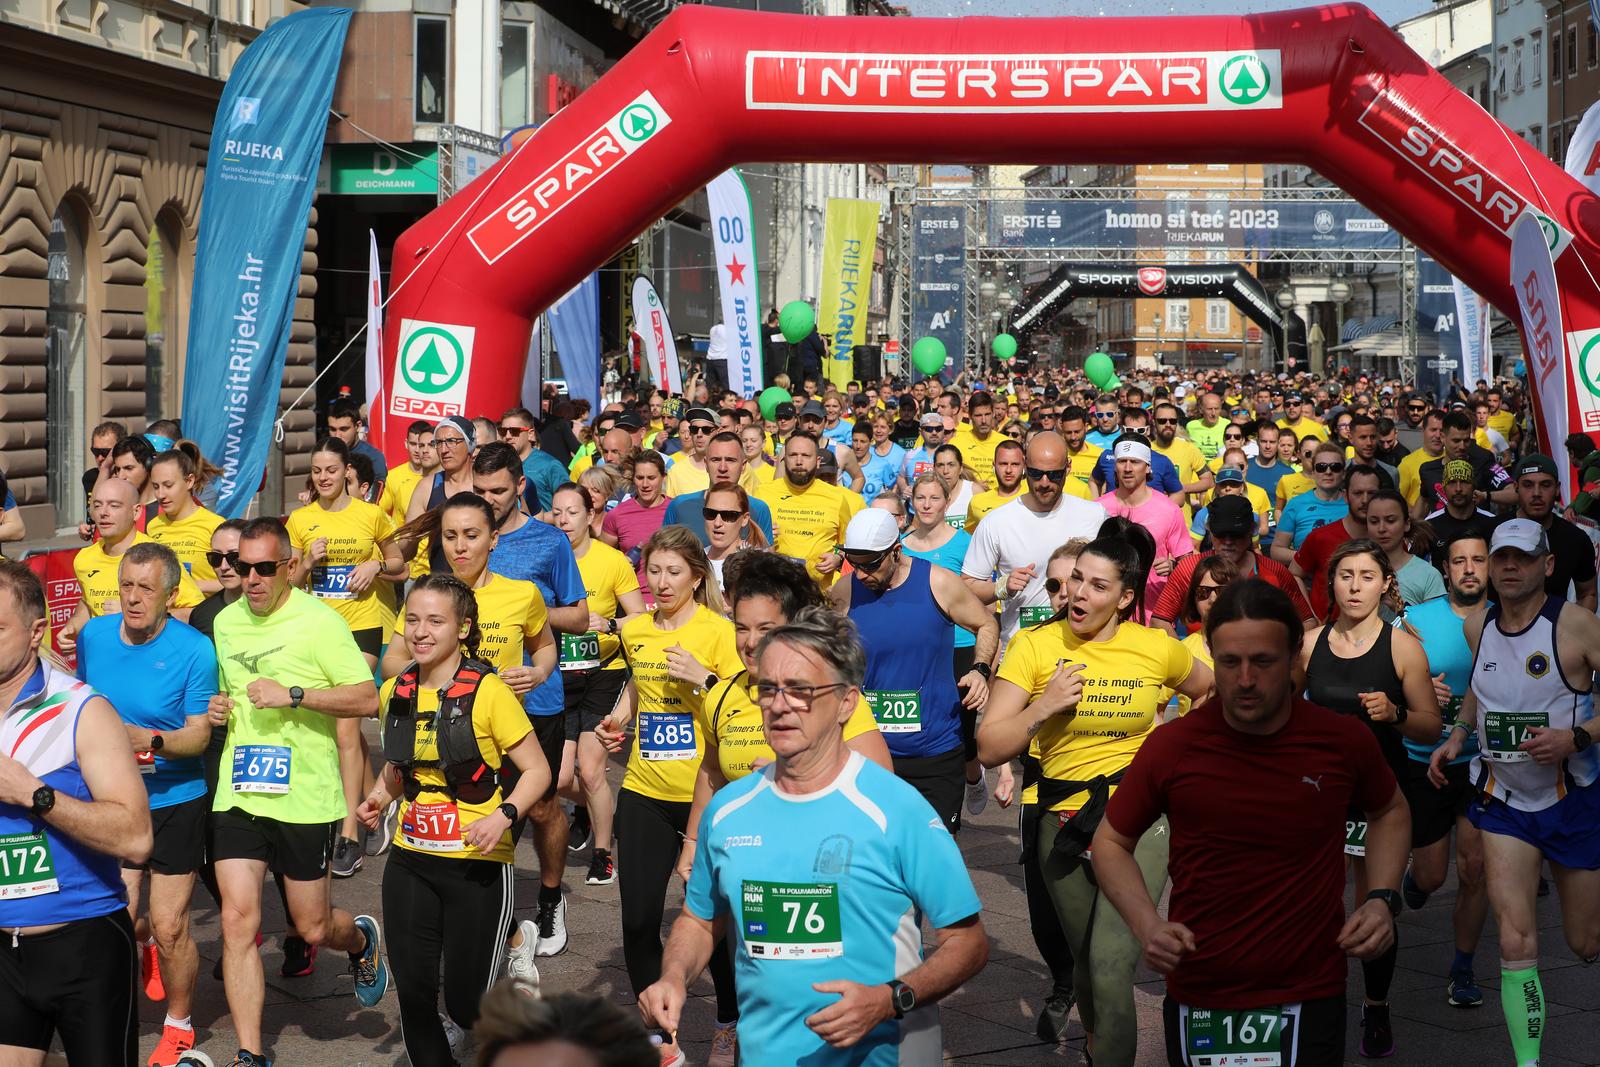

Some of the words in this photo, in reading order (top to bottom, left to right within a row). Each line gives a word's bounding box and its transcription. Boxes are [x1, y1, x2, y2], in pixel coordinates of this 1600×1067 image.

[797, 65, 1202, 99] INTERSPAR
[224, 139, 284, 161] RIJEKA
[355, 180, 415, 188] DEICHMANN
[507, 134, 620, 231] SPAR
[1400, 125, 1519, 224] SPAR
[920, 220, 948, 229] ERSTE
[1002, 215, 1046, 228] ERSTE
[1105, 208, 1162, 229] homo
[1167, 208, 1187, 229] si
[1191, 207, 1223, 229] teć
[1229, 209, 1280, 229] 2023
[1002, 229, 1025, 238] Bank
[1167, 232, 1224, 242] RIJEKARUN
[1078, 273, 1133, 285] SPORT
[1171, 274, 1224, 285] VISION
[832, 238, 861, 362] RIJEKARUN
[929, 309, 951, 330] A1
[1433, 312, 1455, 332] A1
[218, 252, 265, 501] www.visitRijeka.hr
[394, 398, 460, 417] SPAR
[486, 634, 509, 644] drive
[570, 640, 599, 658] 190
[1098, 677, 1108, 687] is
[1111, 677, 1144, 690] magic
[882, 700, 918, 719] 202
[1086, 693, 1133, 706] misery!
[1078, 708, 1095, 717] ask
[1097, 710, 1115, 719] any
[1116, 709, 1145, 718] runner.
[653, 723, 693, 745] 685
[1507, 725, 1545, 746] 14
[247, 756, 289, 779] 675
[415, 813, 457, 836] 517
[0, 845, 50, 877] 172
[744, 892, 763, 903] RUN
[782, 902, 825, 935] 76
[1192, 1010, 1211, 1020] RUN
[1222, 1014, 1278, 1045] 167
